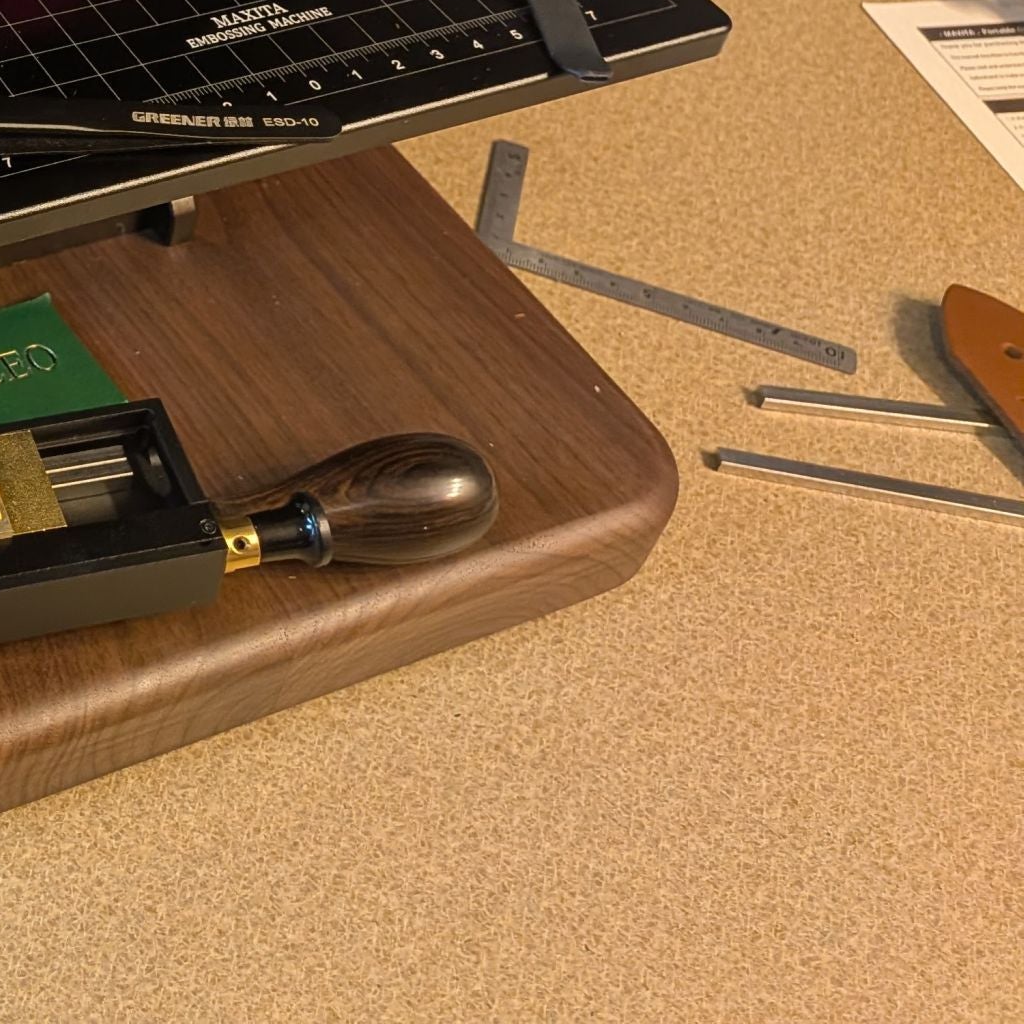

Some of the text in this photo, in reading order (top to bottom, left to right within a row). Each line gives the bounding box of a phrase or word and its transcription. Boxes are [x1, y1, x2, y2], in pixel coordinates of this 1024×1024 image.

[186, 6, 334, 49] EMBOSSING MACHINE
[210, 2, 289, 29] MAXITA
[391, 59, 405, 71] 2
[429, 49, 444, 60] 3
[472, 39, 484, 51] 4
[509, 29, 523, 40] 5
[132, 111, 221, 128] GREENER
[262, 117, 319, 127] ESD-10
